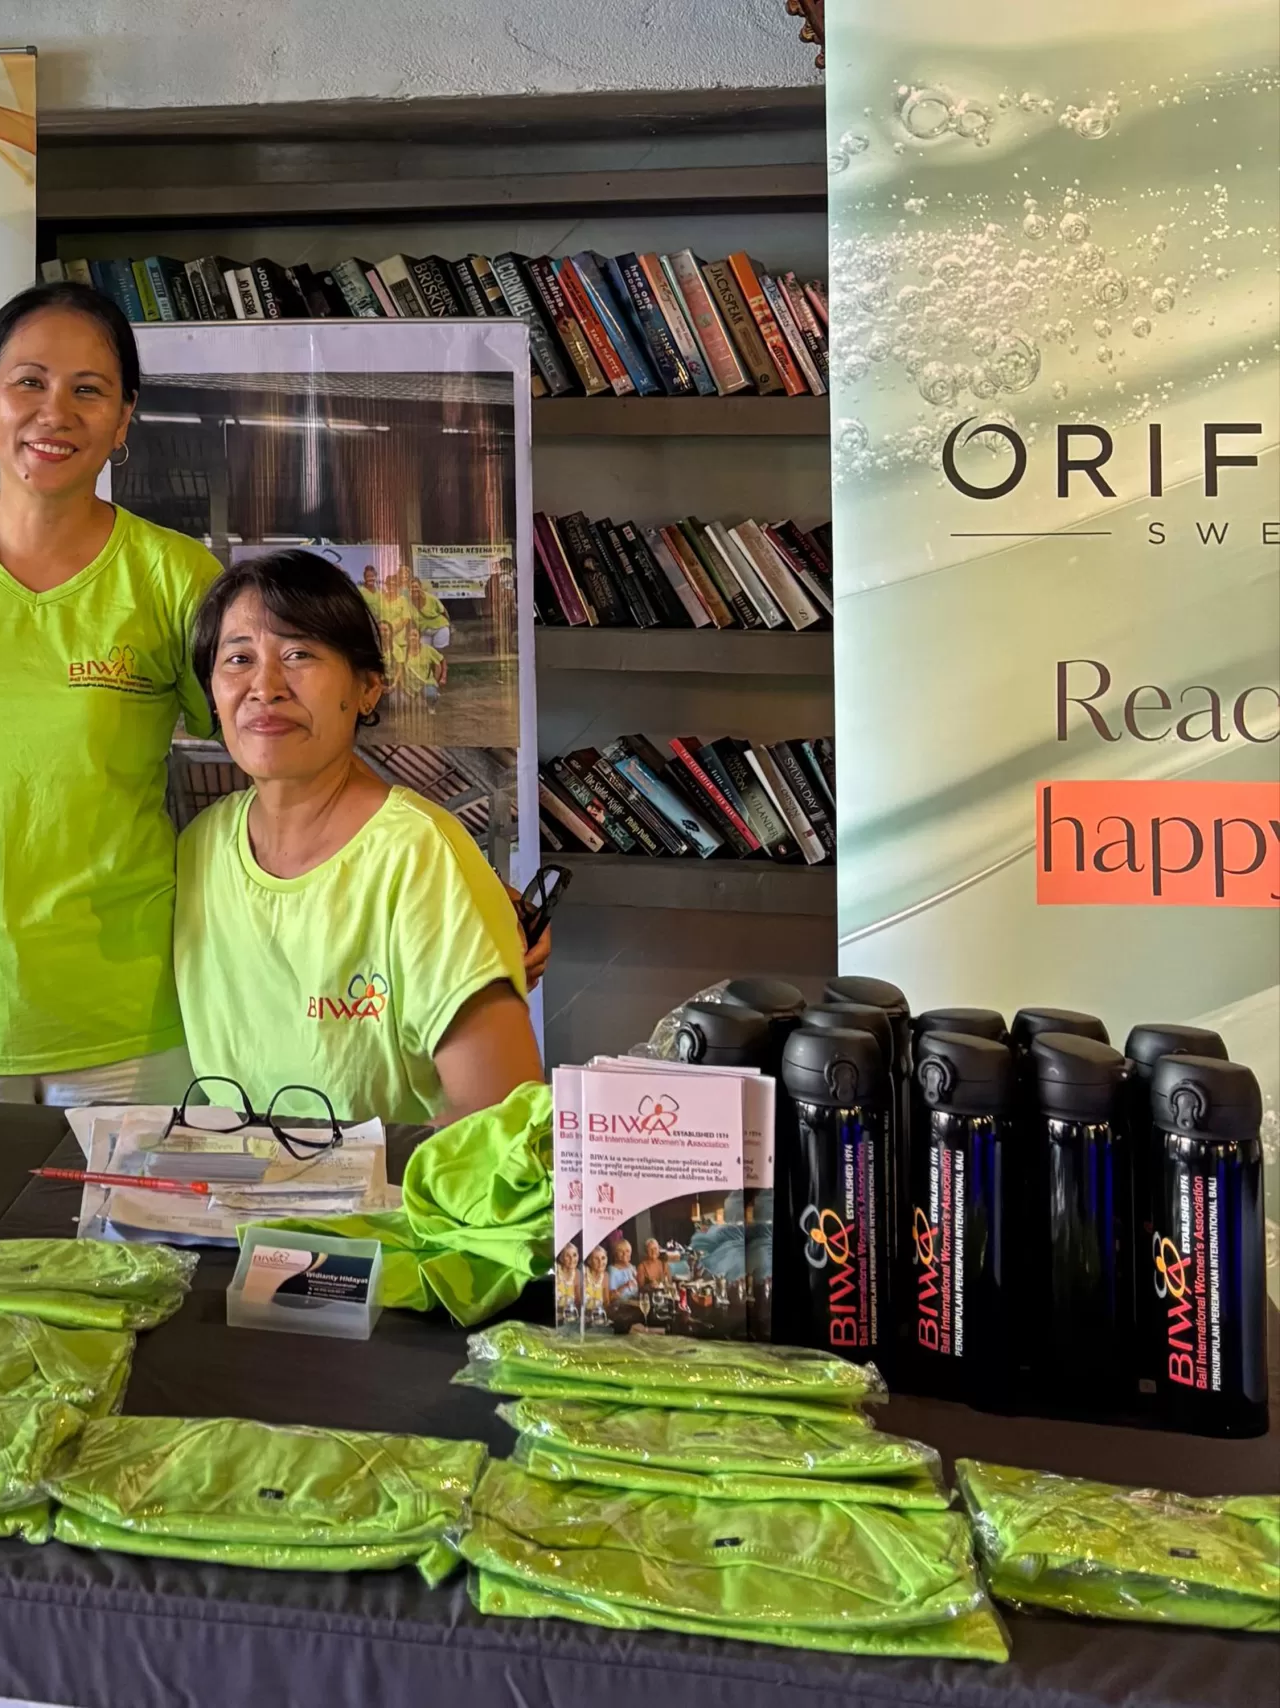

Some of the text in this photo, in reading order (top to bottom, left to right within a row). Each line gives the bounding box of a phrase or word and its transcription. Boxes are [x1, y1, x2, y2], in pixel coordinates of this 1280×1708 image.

[257, 266, 270, 293] JODI
[426, 260, 458, 315] JACQUELINE
[456, 262, 488, 317] TERRY GOODKIN
[496, 262, 532, 317] CORNWEL
[531, 263, 558, 316] Memorandum
[545, 274, 564, 308] Hadrian
[624, 269, 646, 310] moment
[630, 264, 653, 310] here one
[710, 267, 744, 325] JACKSPEAK
[766, 282, 790, 328] Descendants
[806, 331, 818, 351] SING
[942, 416, 1263, 500] ORIF
[69, 660, 130, 679] BIWA
[583, 771, 595, 786] The
[591, 780, 608, 799] Subtle
[607, 797, 624, 815] Knife
[624, 816, 639, 833] Philip
[637, 827, 657, 851] Pullman
[785, 757, 808, 791] SYLVIA
[801, 789, 819, 811] DAY
[1043, 785, 1280, 900] happ
[307, 996, 380, 1022] BIWA
[588, 1112, 671, 1137] BIWA
[589, 1134, 730, 1149] Bali International Women's Association
[673, 1130, 715, 1139] ESTABLISHED
[589, 1153, 608, 1161] BIWA
[709, 1160, 723, 1168] and
[589, 1161, 623, 1170] non-profit
[597, 1168, 608, 1176] the
[608, 1169, 633, 1179] welfare
[678, 1173, 705, 1182] children
[930, 1147, 939, 1223] ESTABLISHED 1974
[589, 1206, 624, 1216] HATTEN
[845, 1164, 855, 1220] ESTABLISHED
[1180, 1174, 1191, 1254] ESTABLISHED 1974
[855, 1142, 869, 1346] Bali International Women's Association
[940, 1149, 952, 1354] Bali International Women's Association
[955, 1150, 964, 1357] PERKUMPULAN PEREMPUAN INTERNATIONAL BALI
[828, 1223, 858, 1347] BIWA
[917, 1226, 939, 1350] BIWA
[1192, 1175, 1208, 1389] Bali International Women's Association
[1208, 1177, 1222, 1391] PERKUMPULAN PEREMPUAN INTERNATIONAL BALI
[1167, 1256, 1194, 1386] BIWA
